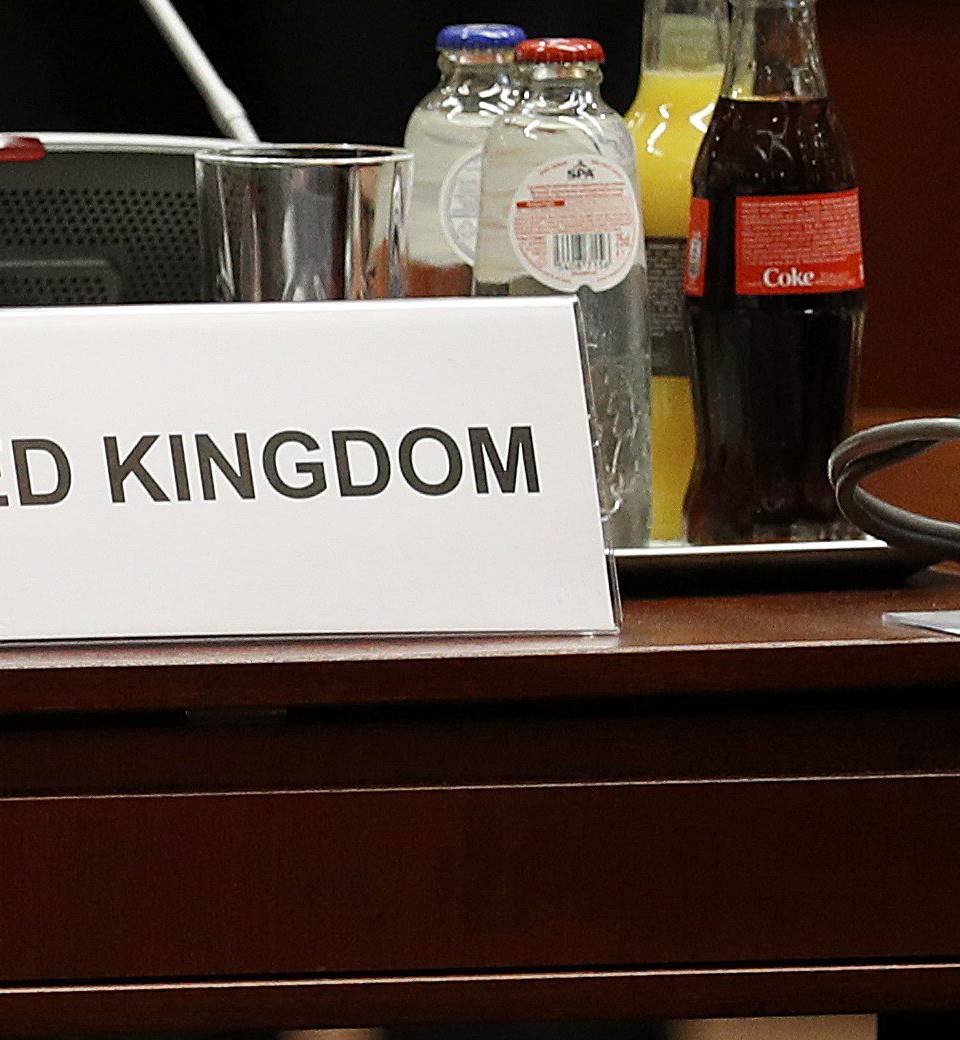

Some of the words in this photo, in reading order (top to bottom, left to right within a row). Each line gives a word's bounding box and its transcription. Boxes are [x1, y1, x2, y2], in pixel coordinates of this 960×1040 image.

[567, 168, 594, 179] SPA
[763, 266, 816, 288] Coke
[104, 426, 539, 503] KINGDOM
